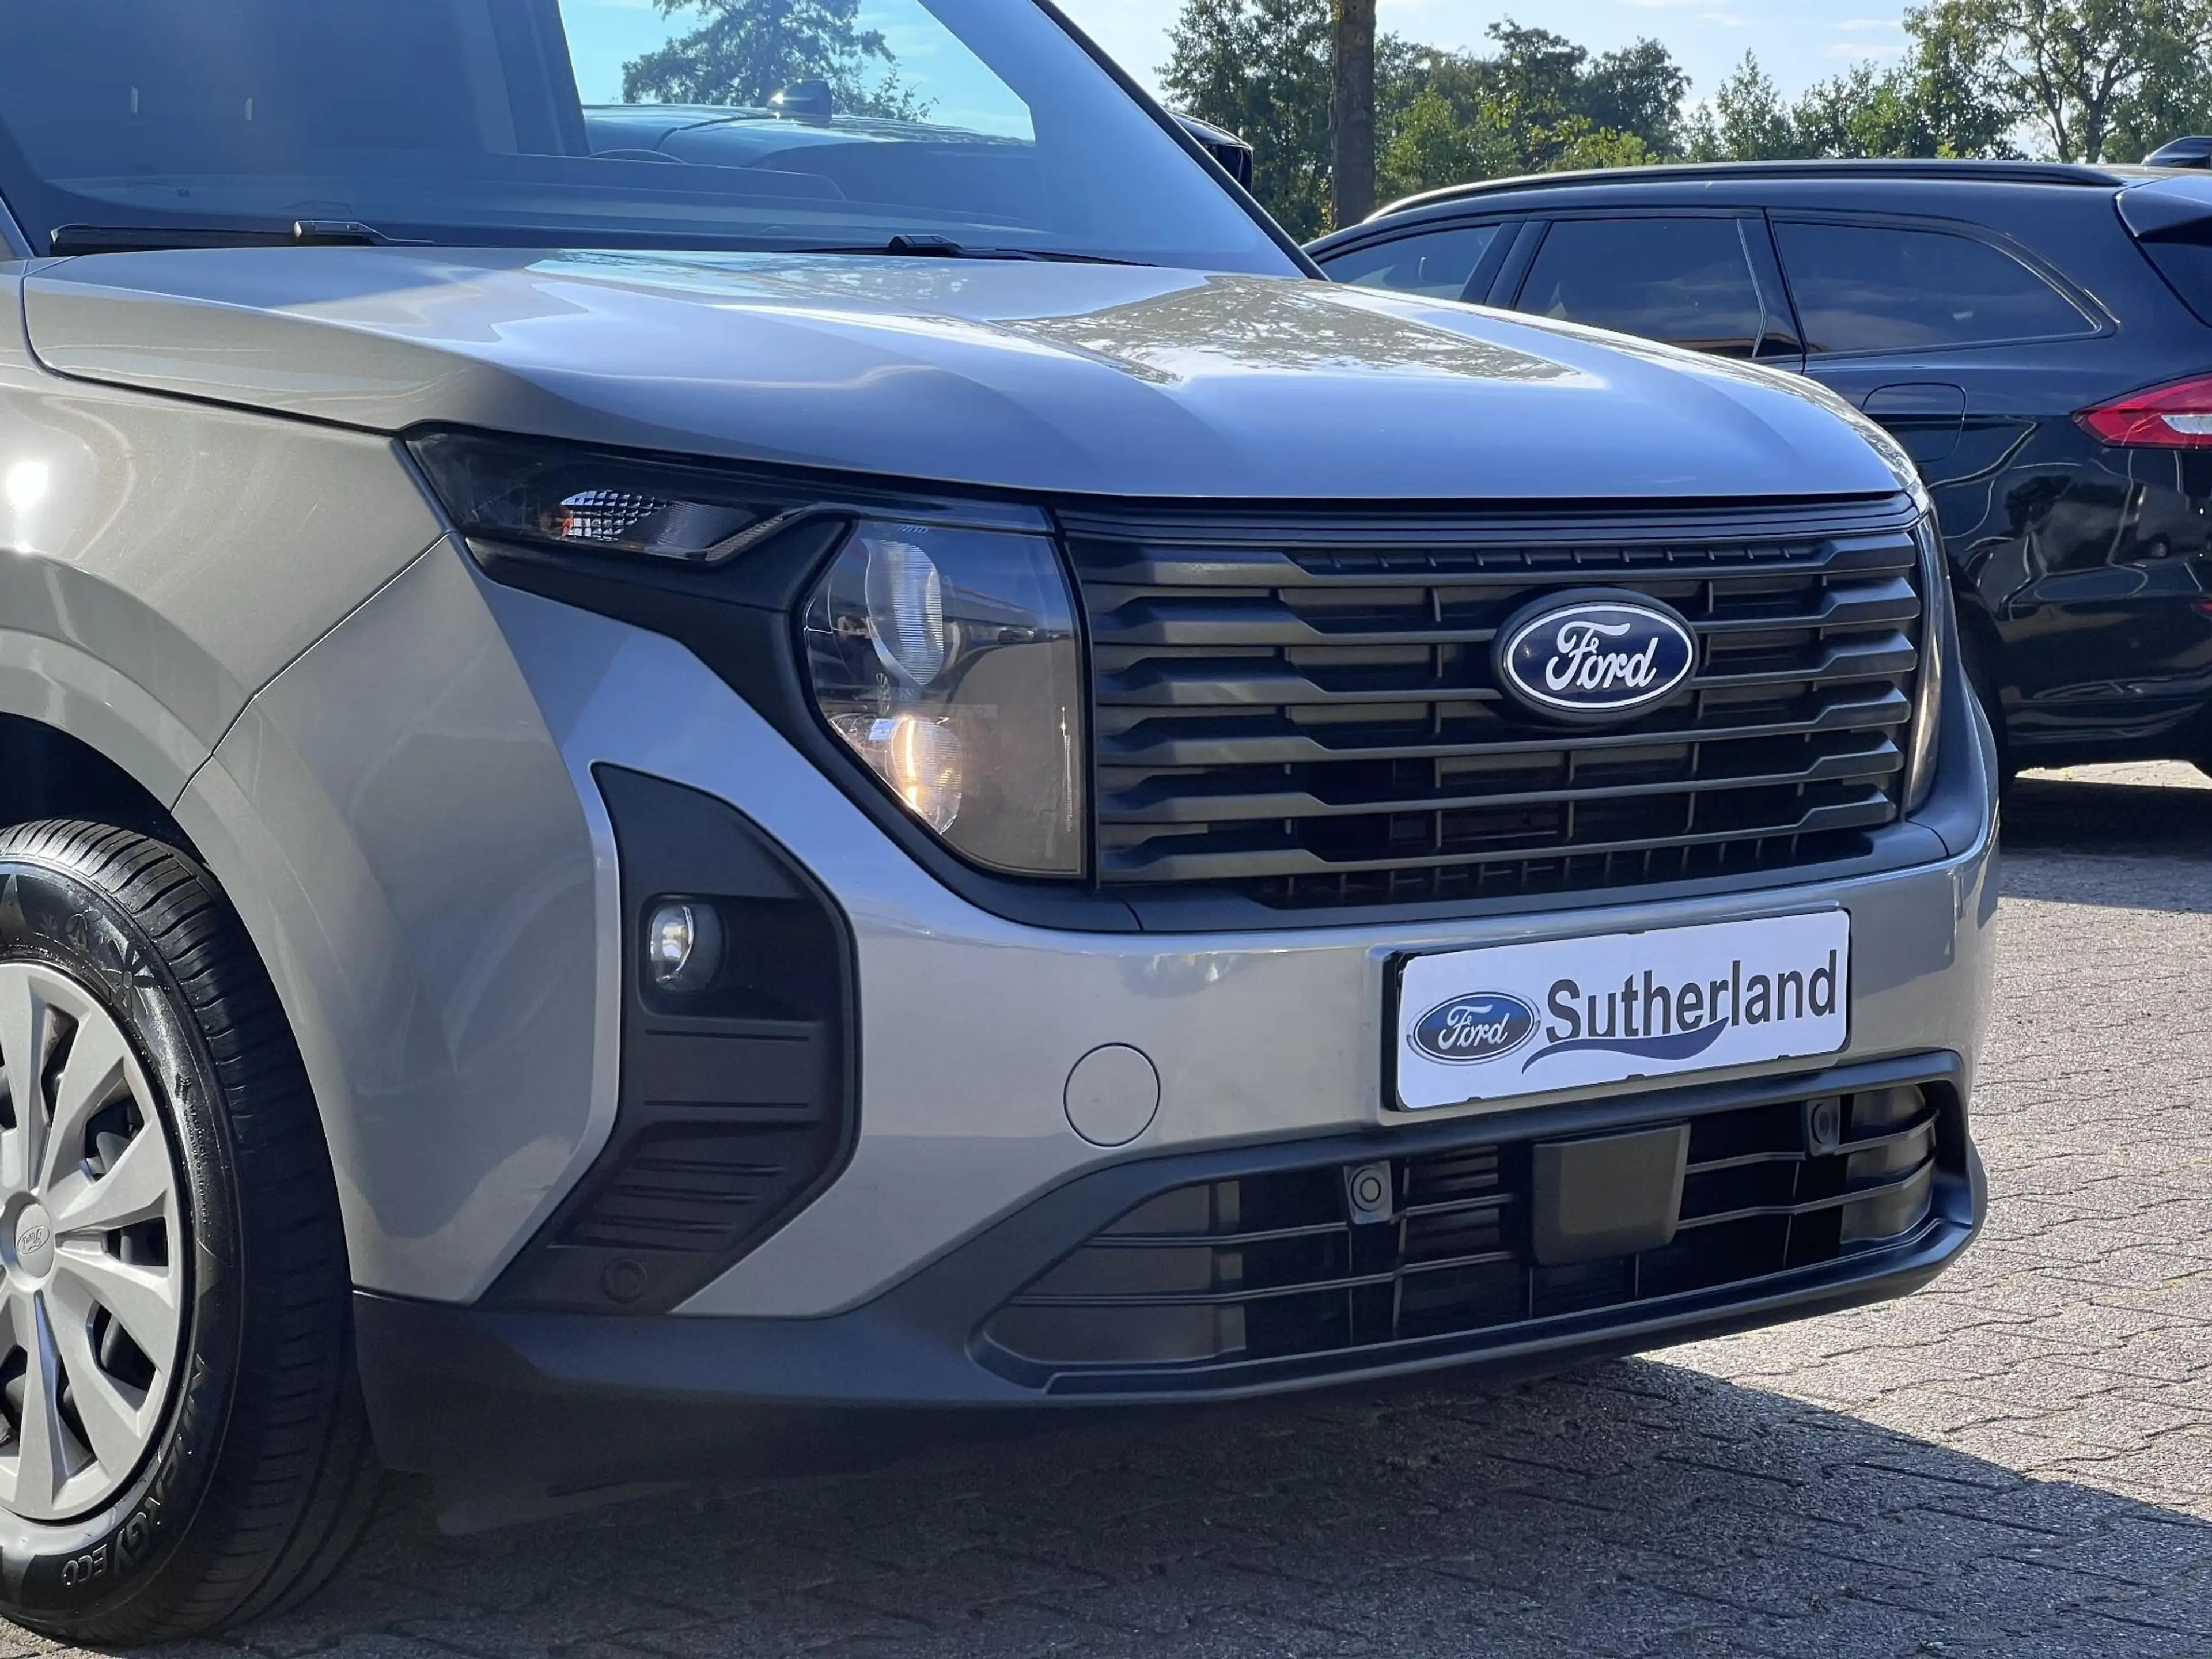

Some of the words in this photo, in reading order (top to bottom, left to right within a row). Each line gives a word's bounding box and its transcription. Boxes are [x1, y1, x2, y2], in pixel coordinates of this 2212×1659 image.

[1546, 620, 1659, 691] Ford
[1438, 1005, 1509, 1049] Ford
[1546, 949, 1837, 1044] Sutherland
